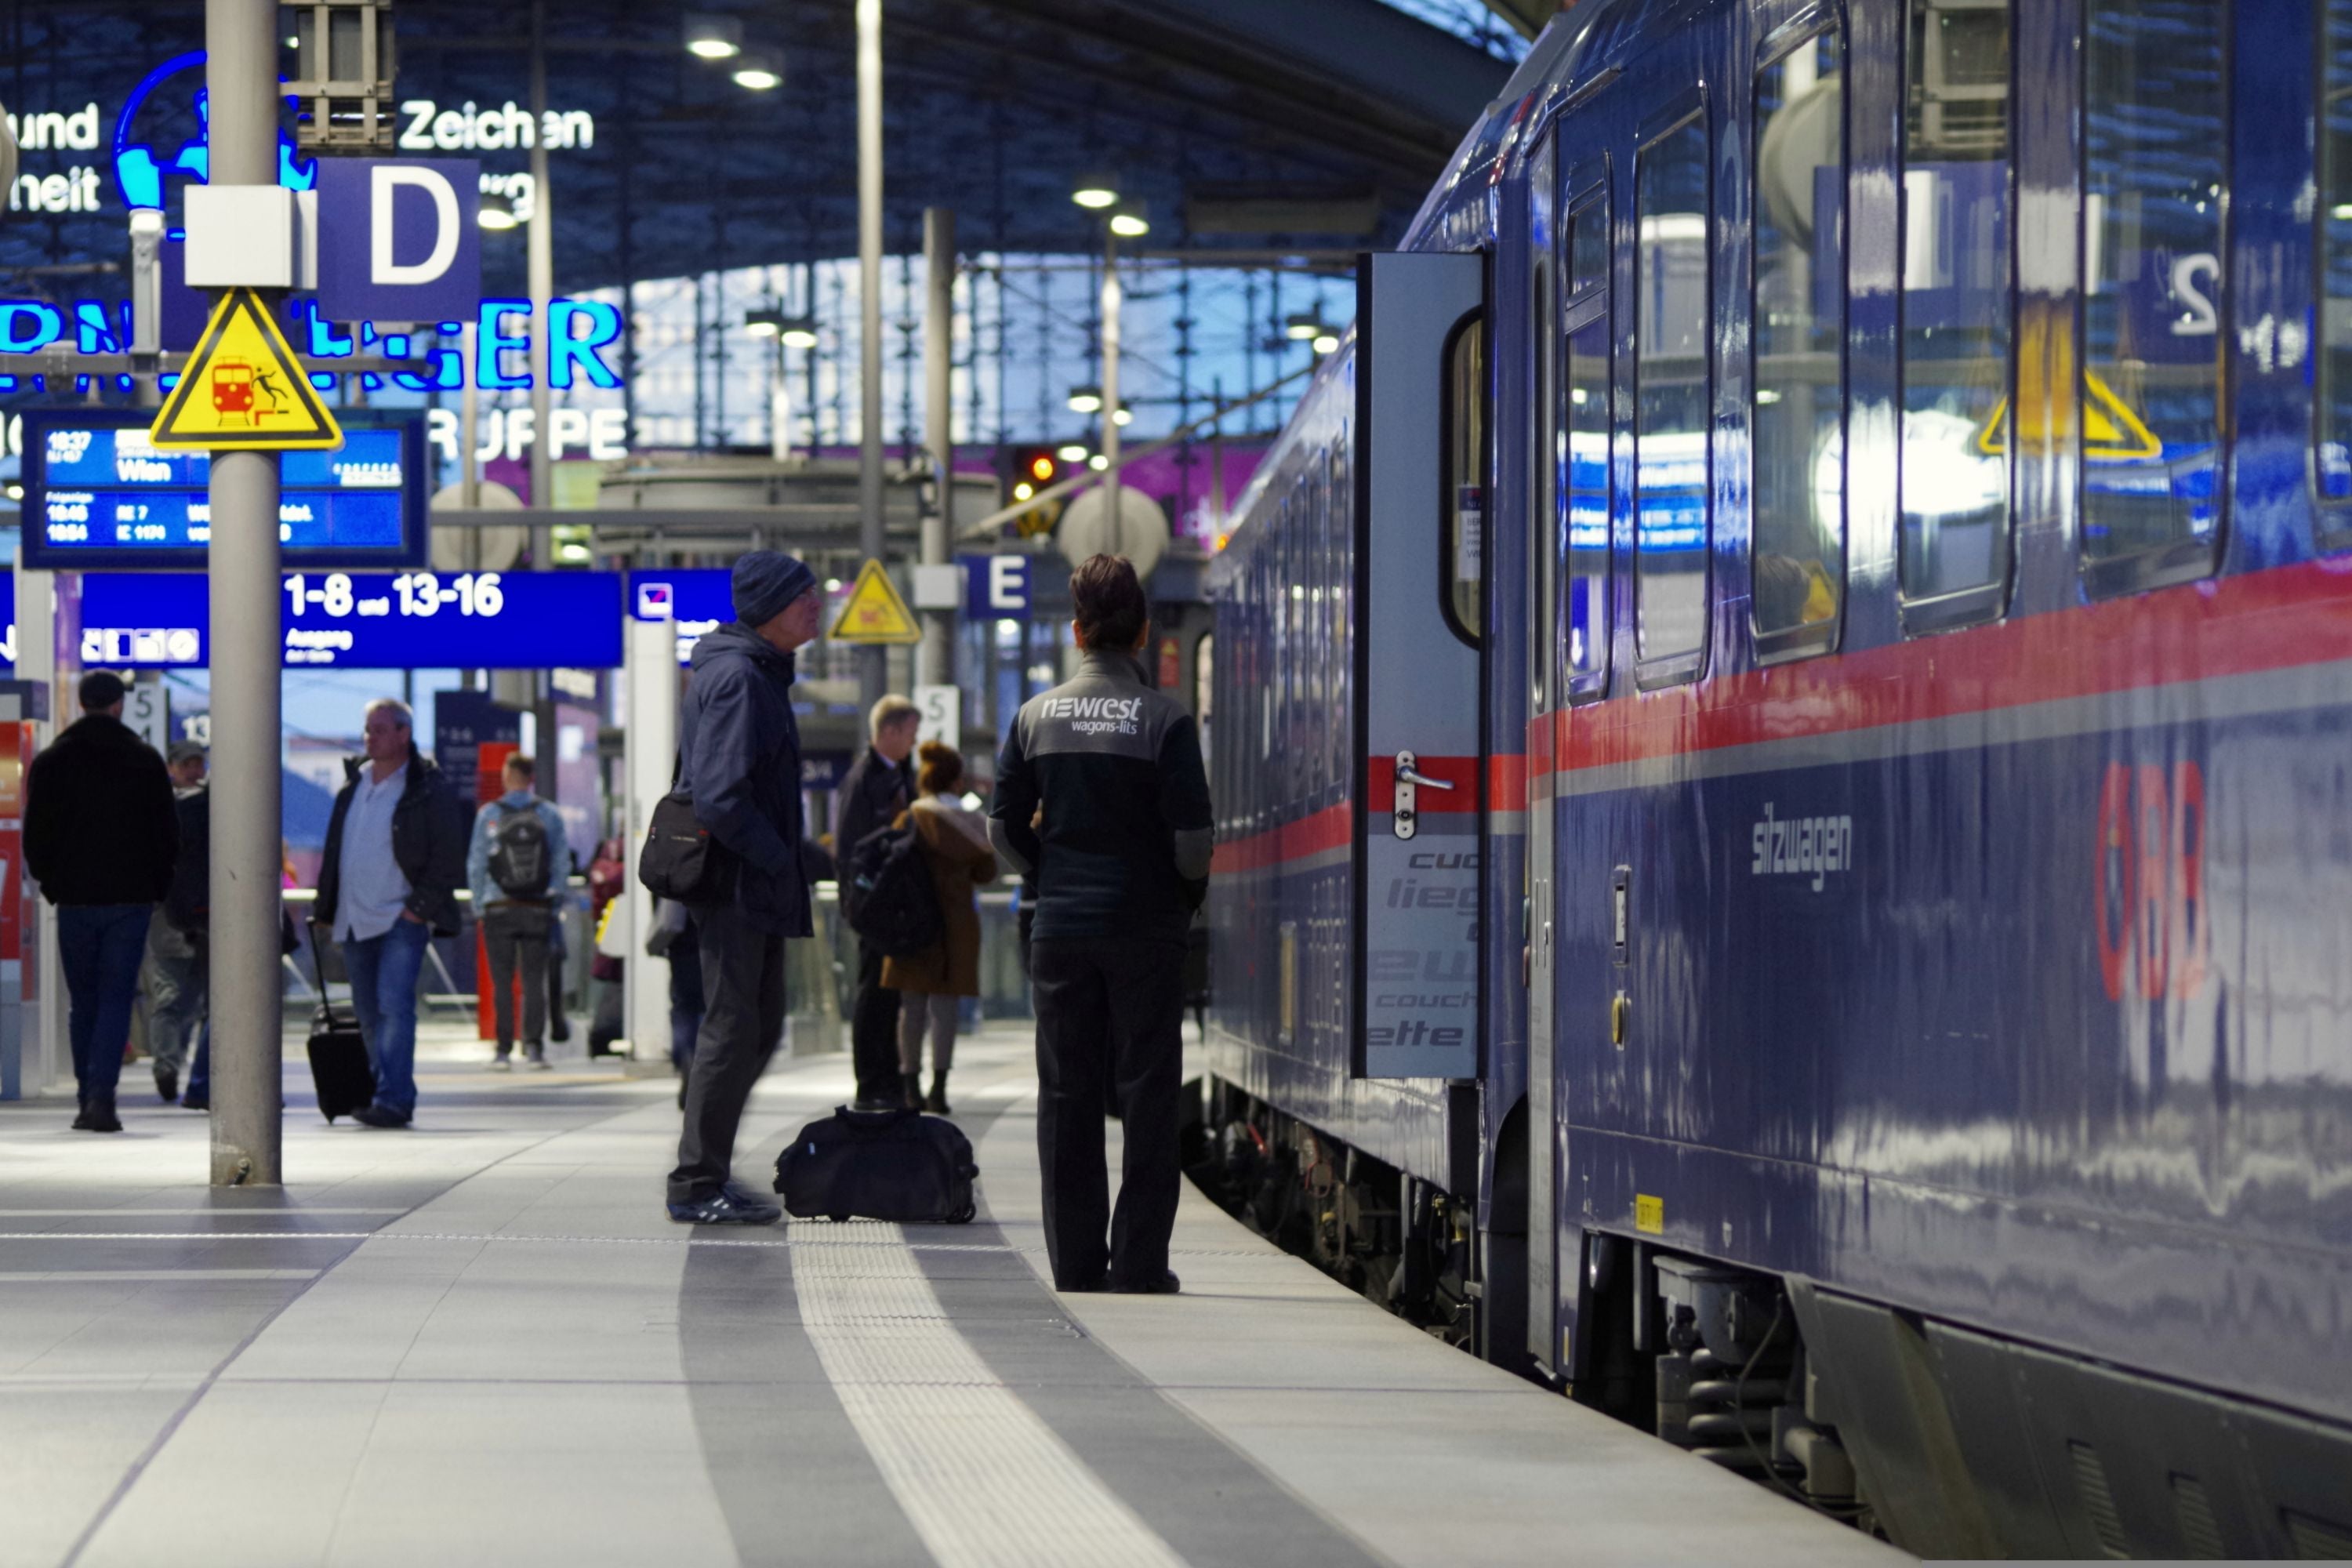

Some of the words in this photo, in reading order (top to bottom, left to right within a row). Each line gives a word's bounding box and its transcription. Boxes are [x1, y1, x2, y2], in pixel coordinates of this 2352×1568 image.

[371, 165, 461, 285] D
[284, 572, 354, 617] 1-8
[392, 572, 504, 617] 13-16
[989, 554, 1025, 609] E
[135, 690, 153, 719] 5
[1072, 720, 1138, 735] wagons-lits
[1751, 800, 1853, 893] sitzwagen
